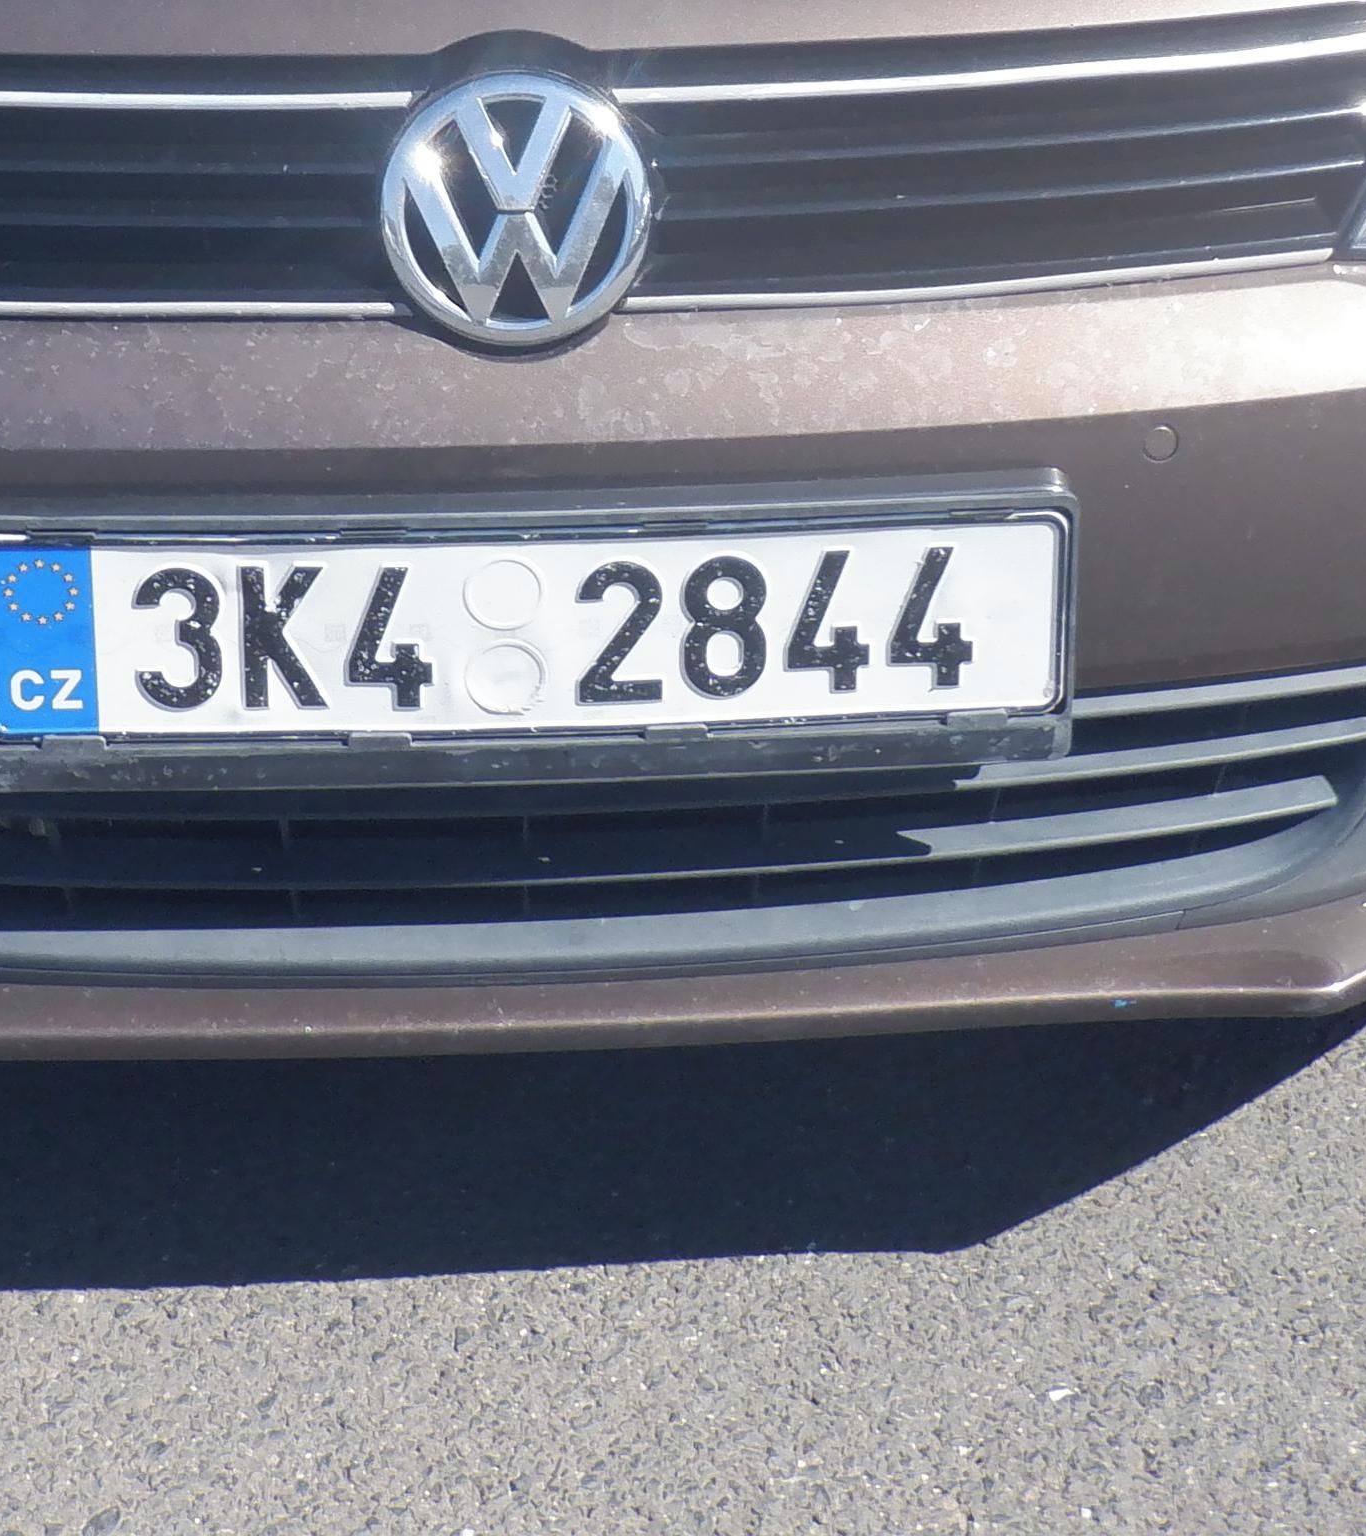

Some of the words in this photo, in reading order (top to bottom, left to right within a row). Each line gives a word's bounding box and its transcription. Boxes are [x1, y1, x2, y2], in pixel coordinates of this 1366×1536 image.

[131, 566, 434, 712] 3K4
[575, 547, 974, 707] 2844
[10, 669, 84, 711] CZ
